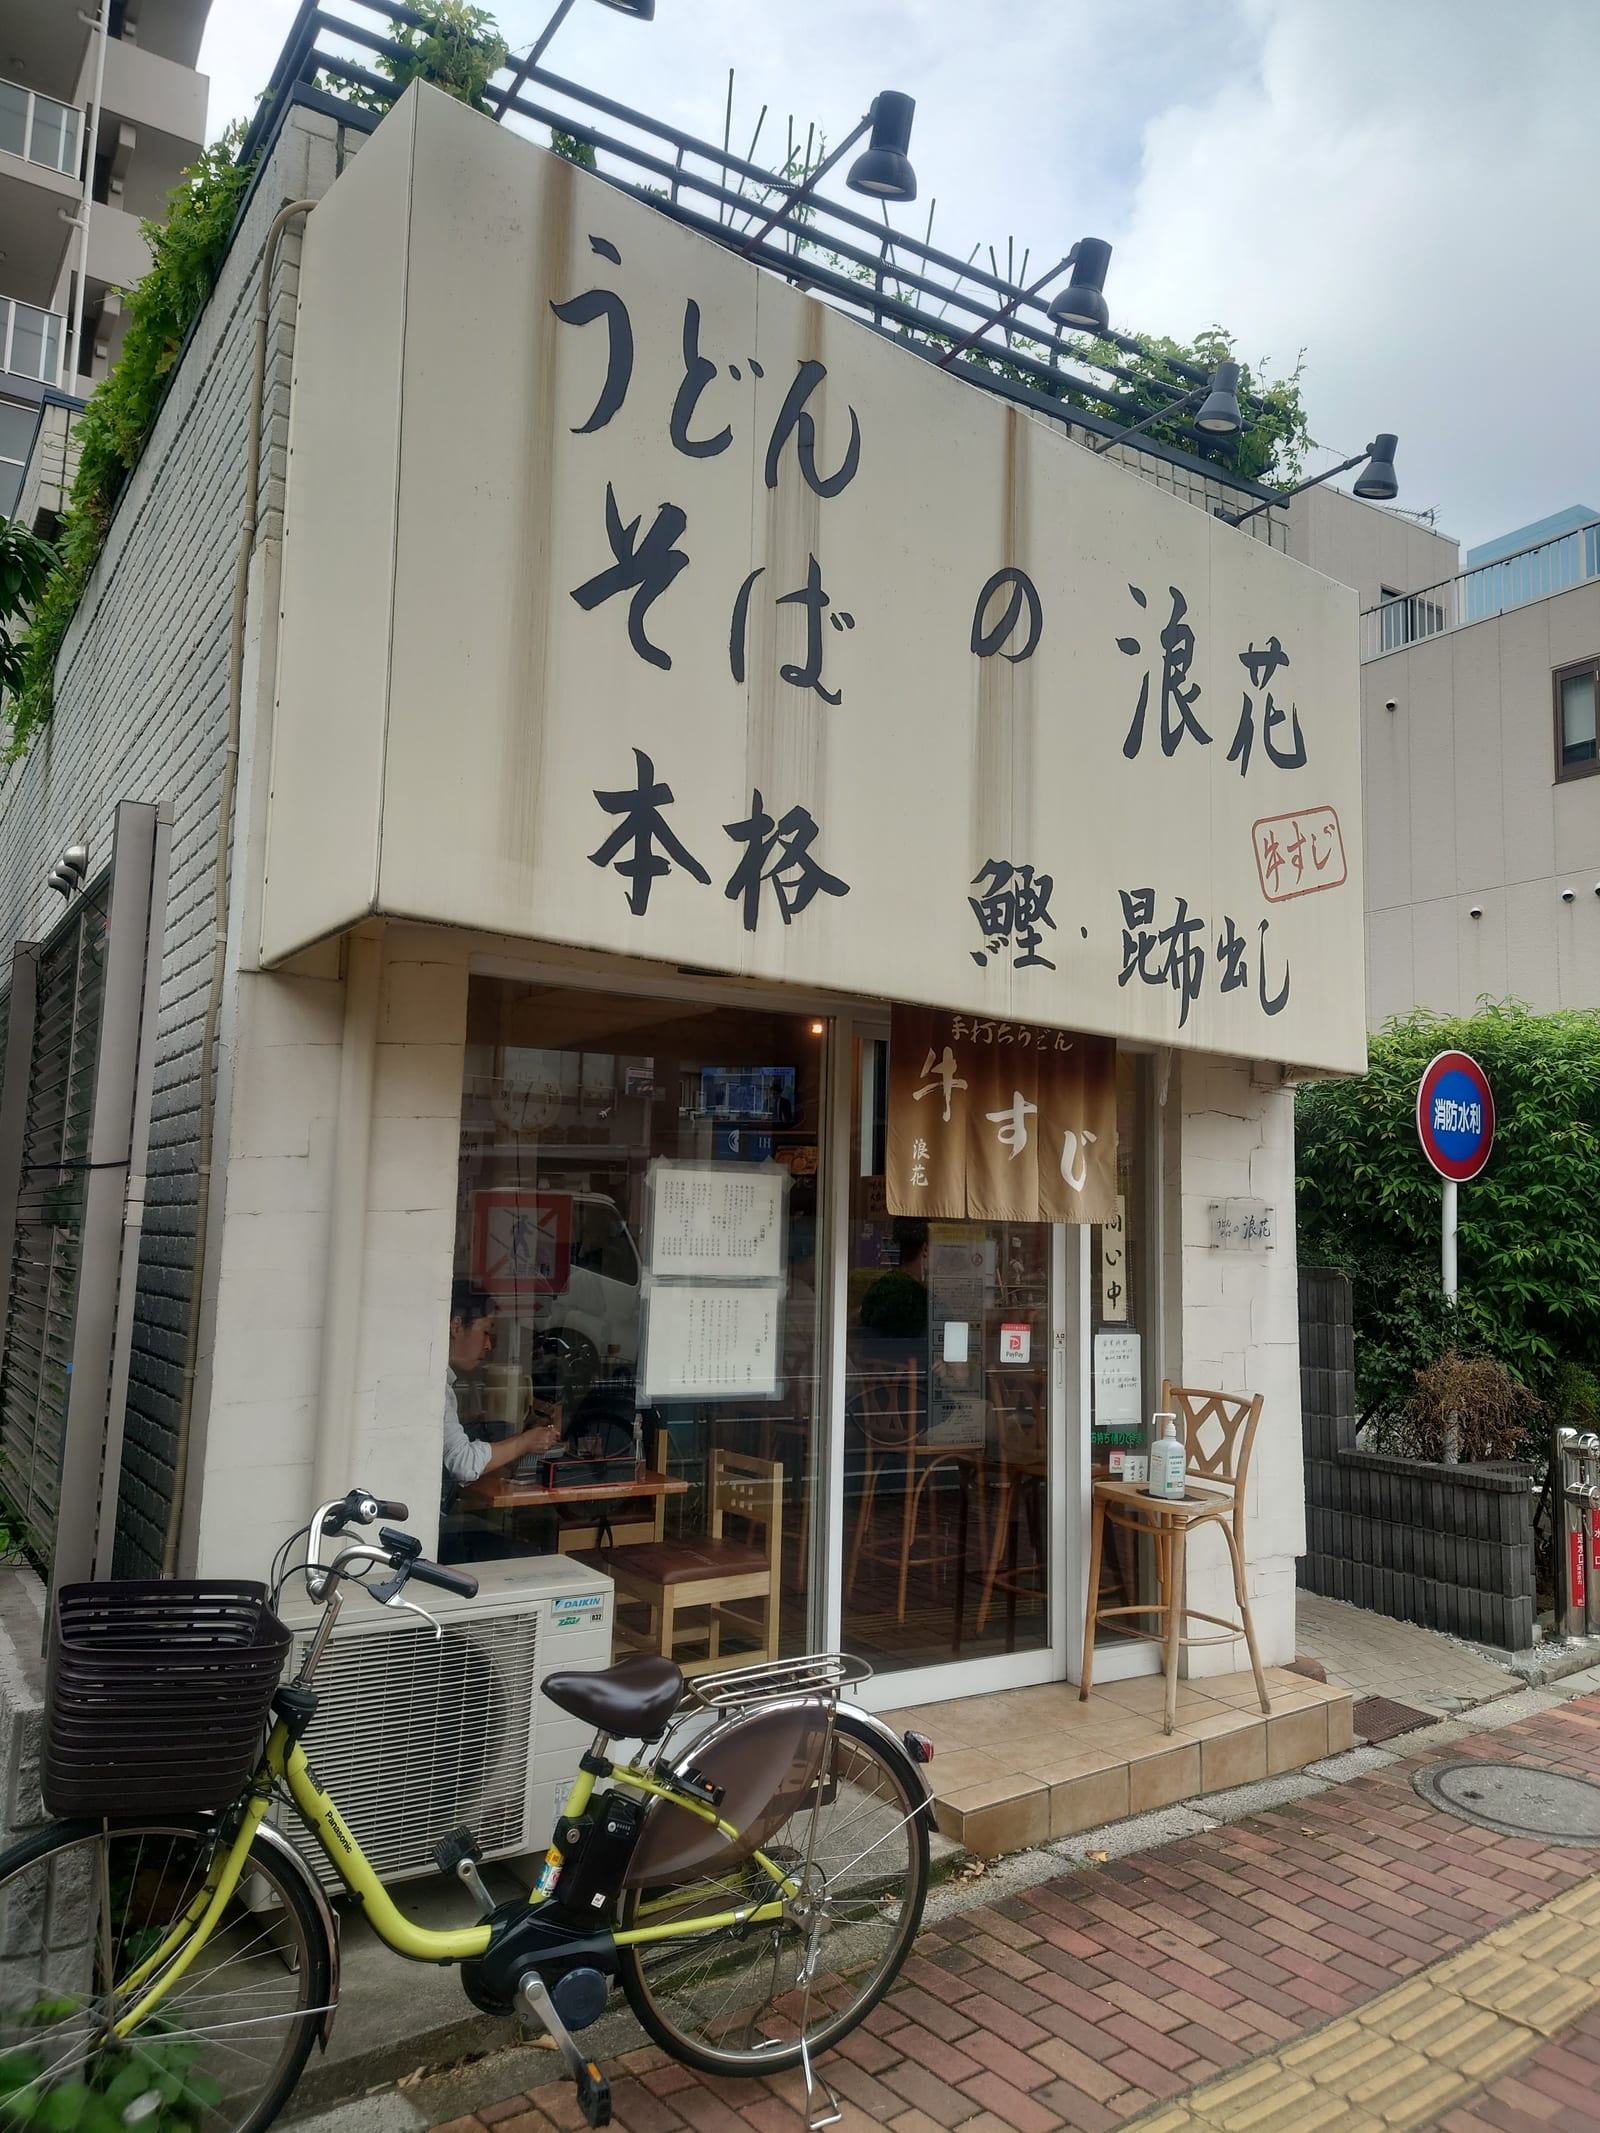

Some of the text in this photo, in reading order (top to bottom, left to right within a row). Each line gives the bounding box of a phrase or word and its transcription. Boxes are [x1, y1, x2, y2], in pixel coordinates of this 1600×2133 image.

[549, 234, 860, 499] うどん
[570, 481, 1308, 778] そば の 浪花
[587, 748, 850, 933] 本格
[1263, 820, 1336, 893] 牛すじ
[912, 1046, 1097, 1193] 牛すじ
[1434, 1098, 1481, 1134] 消防水利
[910, 1138, 930, 1187] 浪花
[1243, 1215, 1270, 1239] 浪花
[1005, 1351, 1024, 1359] PayPay
[564, 1598, 601, 1608] DAIKIN
[325, 1810, 353, 1854] Panasonic
